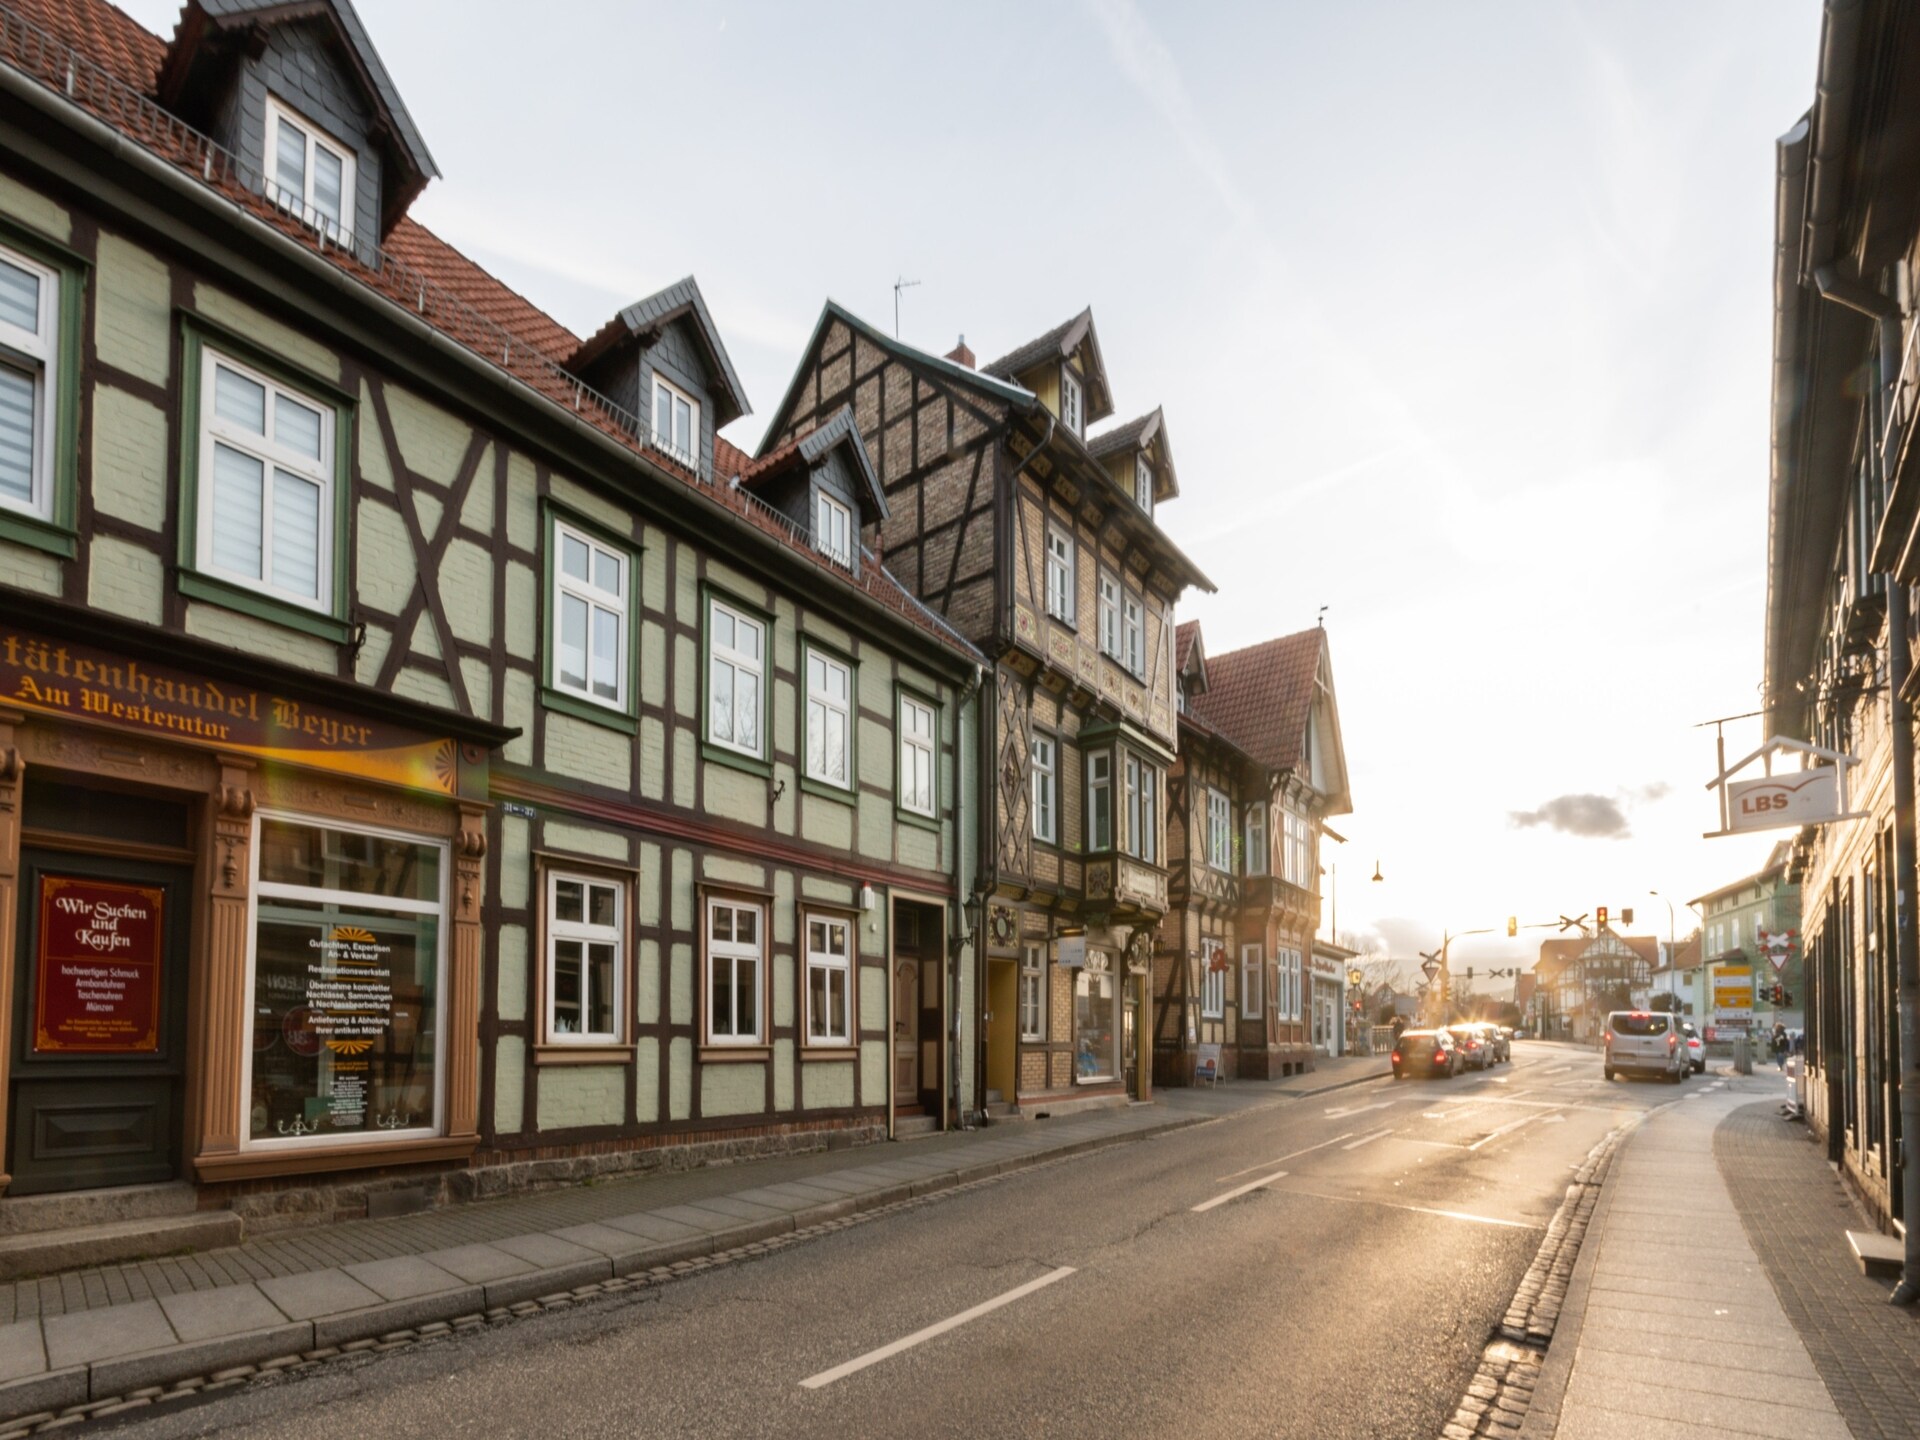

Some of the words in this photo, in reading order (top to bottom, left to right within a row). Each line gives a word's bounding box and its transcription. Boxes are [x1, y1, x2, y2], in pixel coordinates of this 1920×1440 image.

[14, 675, 71, 707] Am
[80, 688, 230, 740] Westerntor
[270, 697, 372, 746] Beyer
[1741, 793, 1789, 814] LBS
[56, 897, 93, 914] Wir
[94, 902, 147, 919] Suchen
[91, 918, 118, 931] und
[75, 929, 131, 952] Kaufen
[309, 939, 351, 951] Gutachten,
[352, 942, 391, 953] Expertisen
[343, 952, 349, 960] &
[350, 952, 379, 960] Verkauf
[61, 964, 108, 978] hochwertigen
[109, 967, 140, 979] Schmuck
[307, 965, 390, 977] Restaurationswerkstatt
[75, 978, 126, 989] Armbanduhren
[309, 980, 352, 990] Übernahme
[353, 983, 390, 992] kompletter
[77, 990, 123, 1001] Taschenuhren
[306, 991, 347, 1000] Nachlässe,
[347, 992, 393, 1001] Sammlungen
[86, 1002, 114, 1012] Münzen
[308, 1000, 314, 1008] &
[316, 1000, 391, 1011] Nachlassbearbeitung
[308, 1015, 350, 1026] Anlieferung
[351, 1016, 357, 1024] &
[357, 1016, 390, 1026] Abholung
[361, 1026, 383, 1035] Möbel
